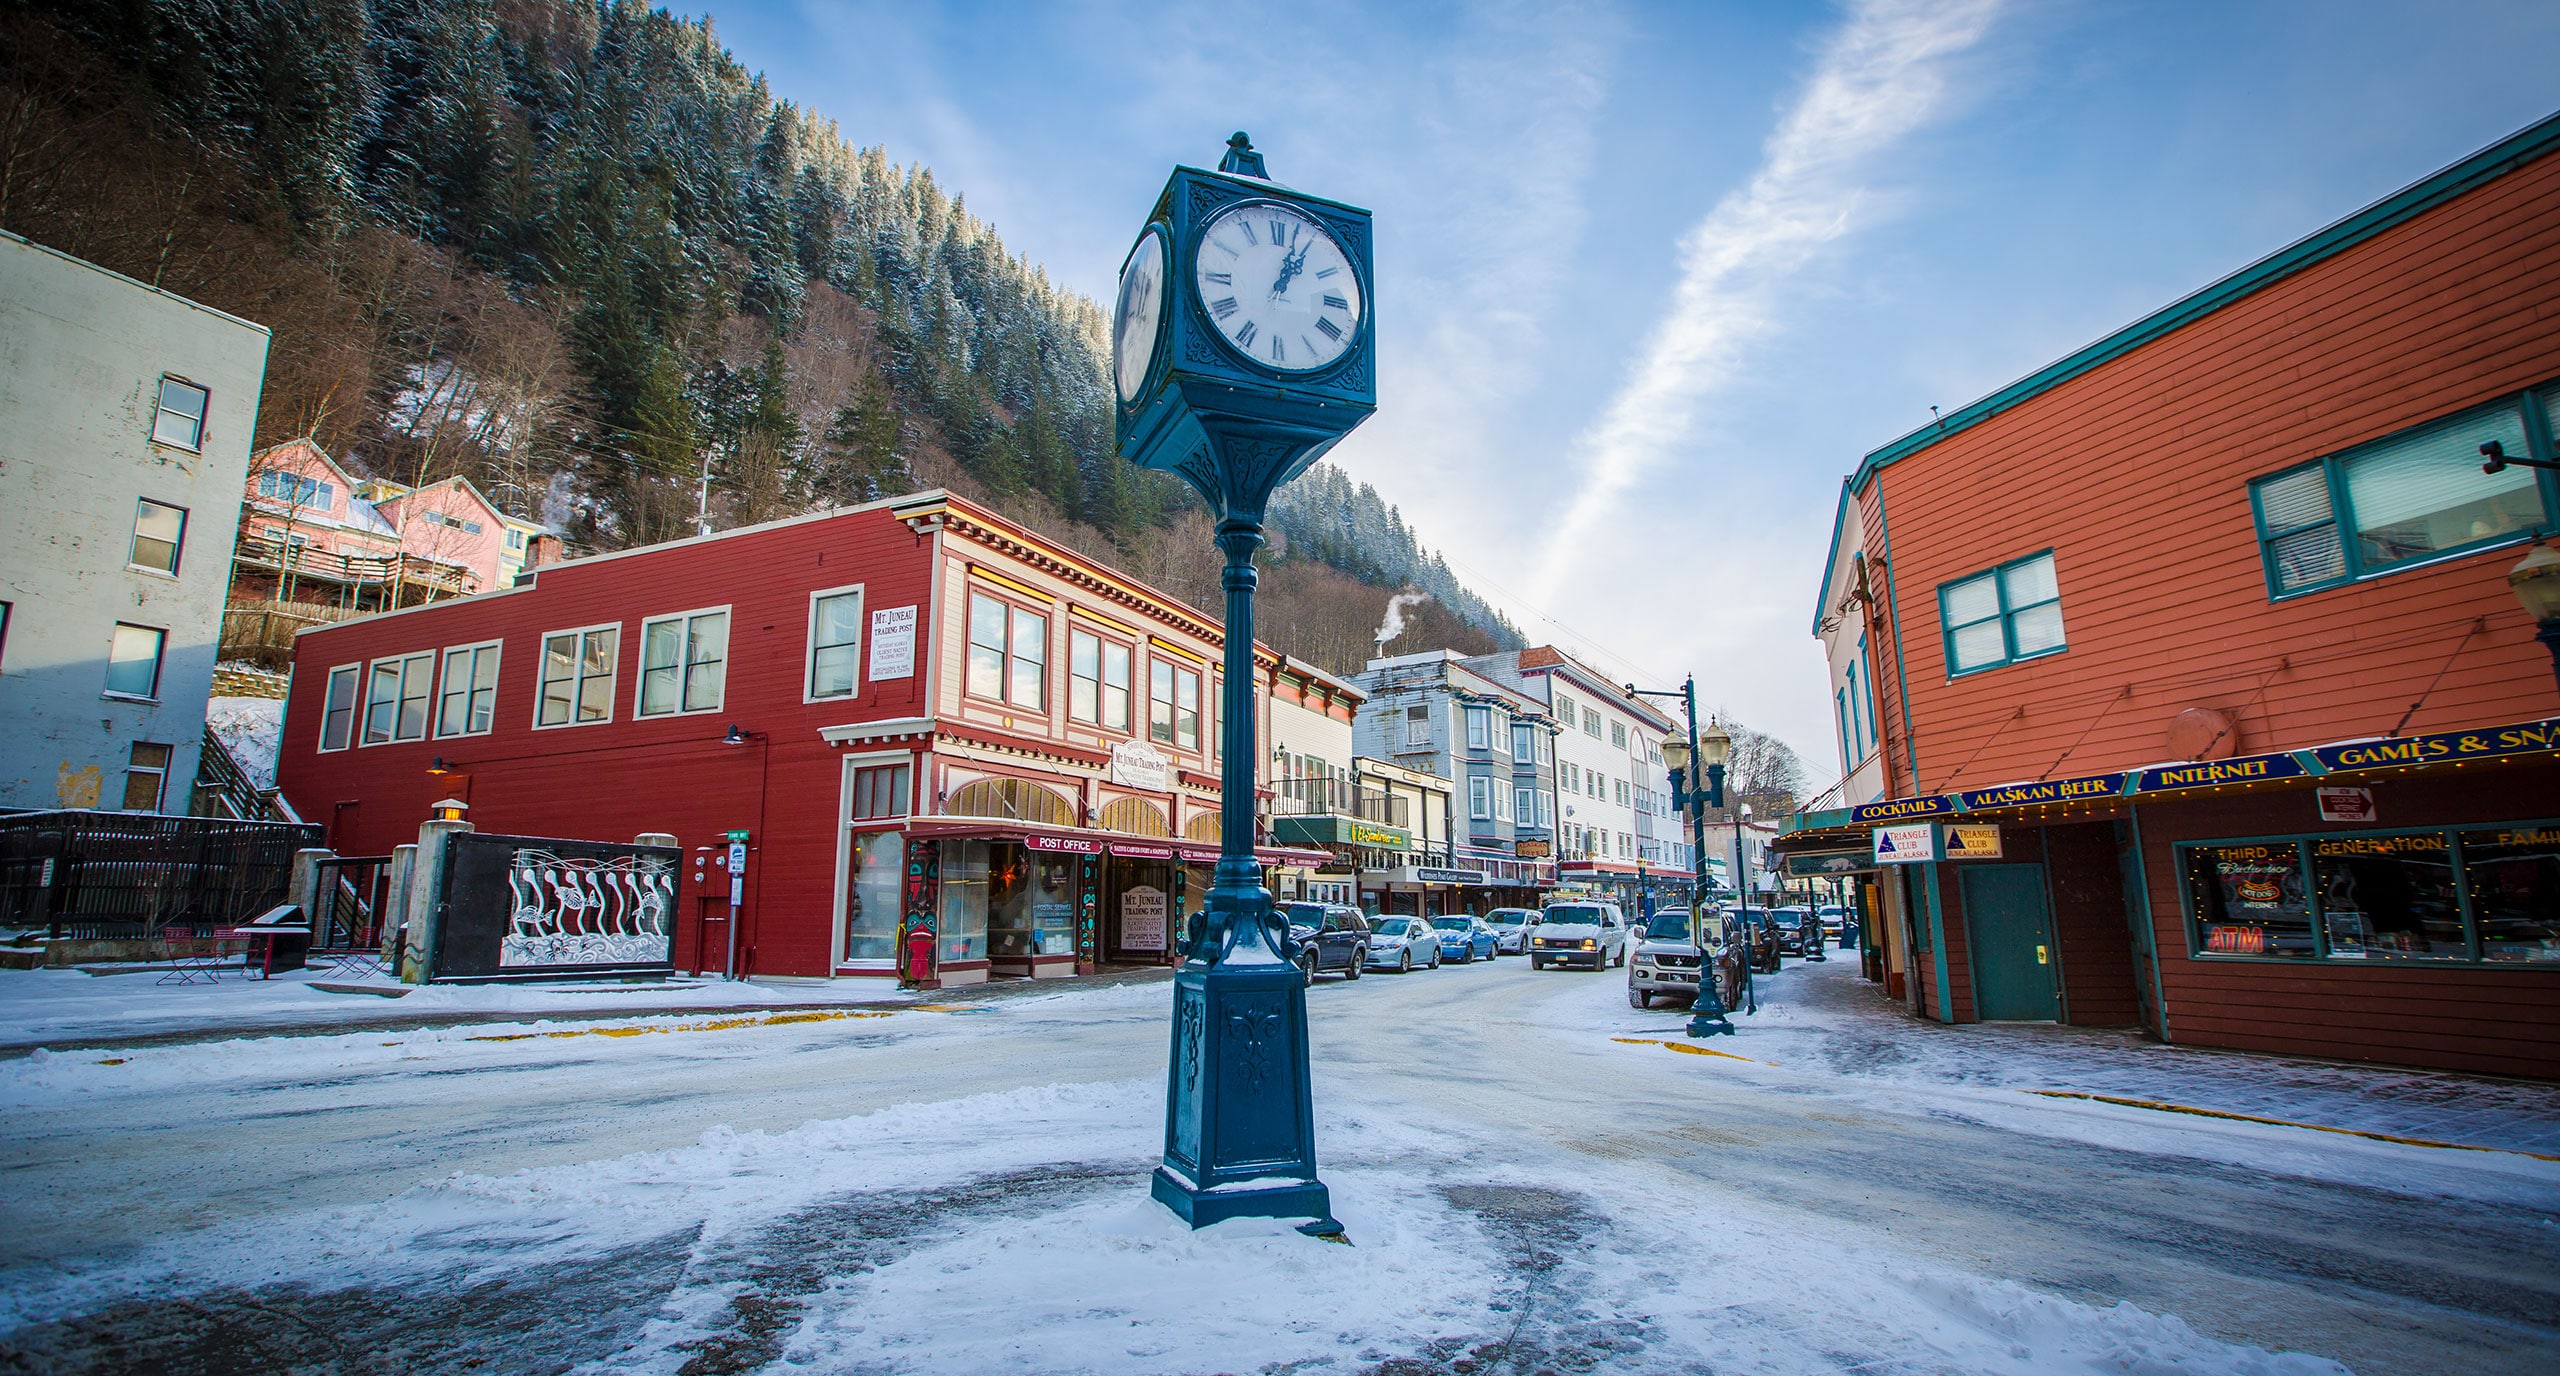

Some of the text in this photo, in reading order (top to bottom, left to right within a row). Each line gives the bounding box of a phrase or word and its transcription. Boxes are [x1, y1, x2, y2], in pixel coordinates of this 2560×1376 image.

[1270, 220, 1286, 247] XII
[1211, 296, 1238, 321] VIII
[1324, 295, 1348, 310] III
[1236, 320, 1258, 348] VII
[888, 610, 914, 624] JUNEAU
[875, 624, 912, 636] TRADING POST
[2339, 738, 2449, 764] GAMES
[2458, 735, 2490, 753] &
[2161, 760, 2268, 785] INTERNET
[1975, 779, 2108, 806] ALASKAN BEER
[1862, 800, 1938, 818] COCKTAILS
[1888, 830, 1928, 840] TRIANGLE
[1958, 830, 1997, 838] TRIANGLE
[1040, 838, 1091, 851] POST OFFICE
[1897, 841, 1918, 850] CLUB
[1967, 840, 1987, 848] CLUB
[2217, 847, 2268, 860] THIRD
[2319, 838, 2444, 856] GENERATION
[2217, 862, 2289, 874] Budweiser
[2242, 888, 2255, 898] HOT
[1138, 895, 1164, 907] JUNEAU
[2208, 926, 2264, 953] ATM
